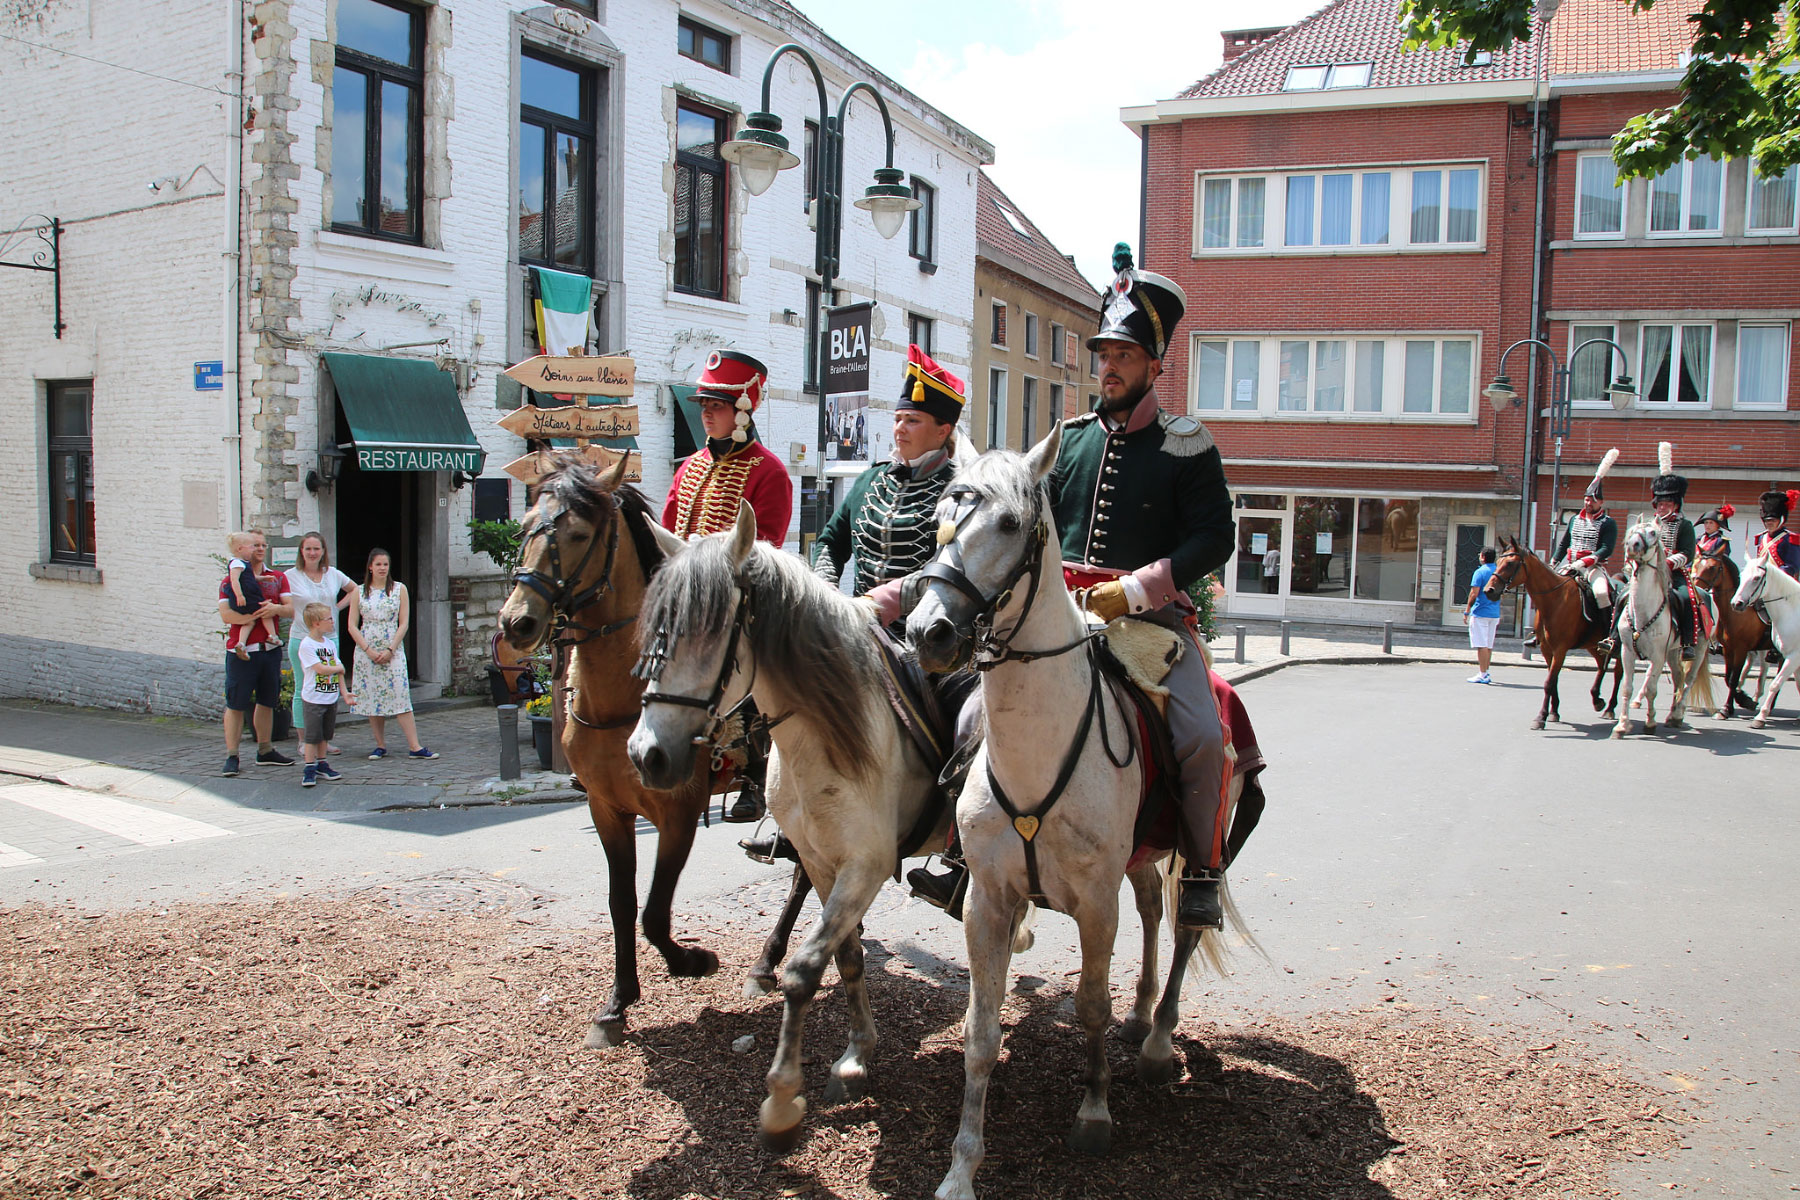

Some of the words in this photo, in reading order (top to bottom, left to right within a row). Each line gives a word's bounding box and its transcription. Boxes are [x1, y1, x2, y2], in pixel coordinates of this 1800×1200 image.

[831, 325, 867, 360] BL'A
[540, 364, 574, 382] Soins
[597, 366, 628, 385] blessés
[830, 361, 867, 374] Braine-l'Alleud
[533, 412, 571, 435] Métiers
[358, 450, 477, 470] RESTAURANT
